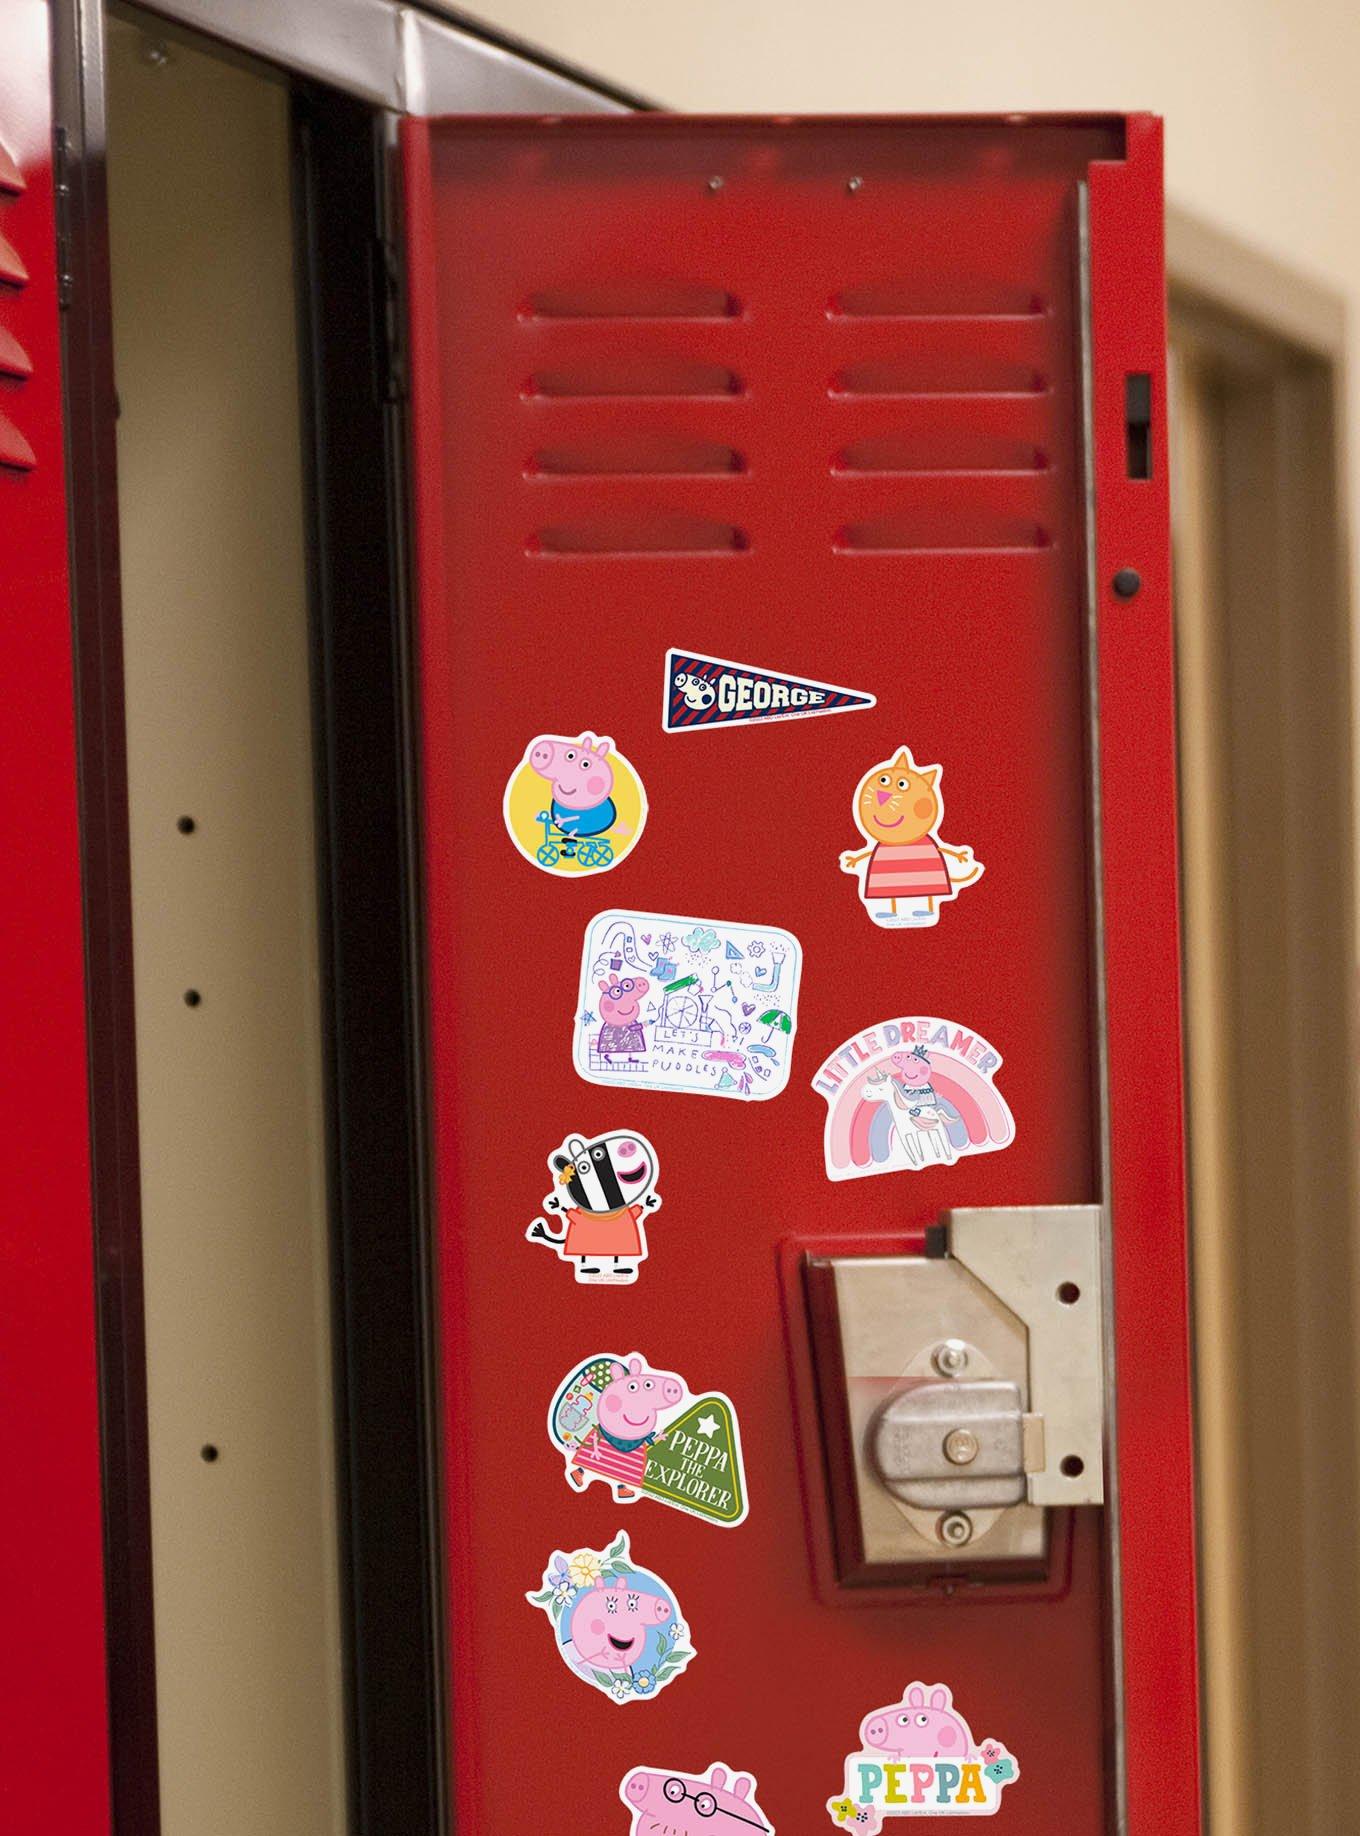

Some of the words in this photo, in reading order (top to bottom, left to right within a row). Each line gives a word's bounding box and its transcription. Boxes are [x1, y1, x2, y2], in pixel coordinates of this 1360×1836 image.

[718, 673, 826, 713] GEORGE
[652, 1044, 699, 1060] MAKE
[664, 1028, 699, 1043] LET'S
[652, 1059, 717, 1077] PUDDLES
[815, 1031, 884, 1095] LITTLE
[882, 1020, 999, 1075] DREAMER
[668, 1429, 729, 1473] PEPPA
[680, 1457, 707, 1479] THE
[645, 1459, 733, 1511] EXPLORER
[857, 1763, 987, 1804] PEPPA
